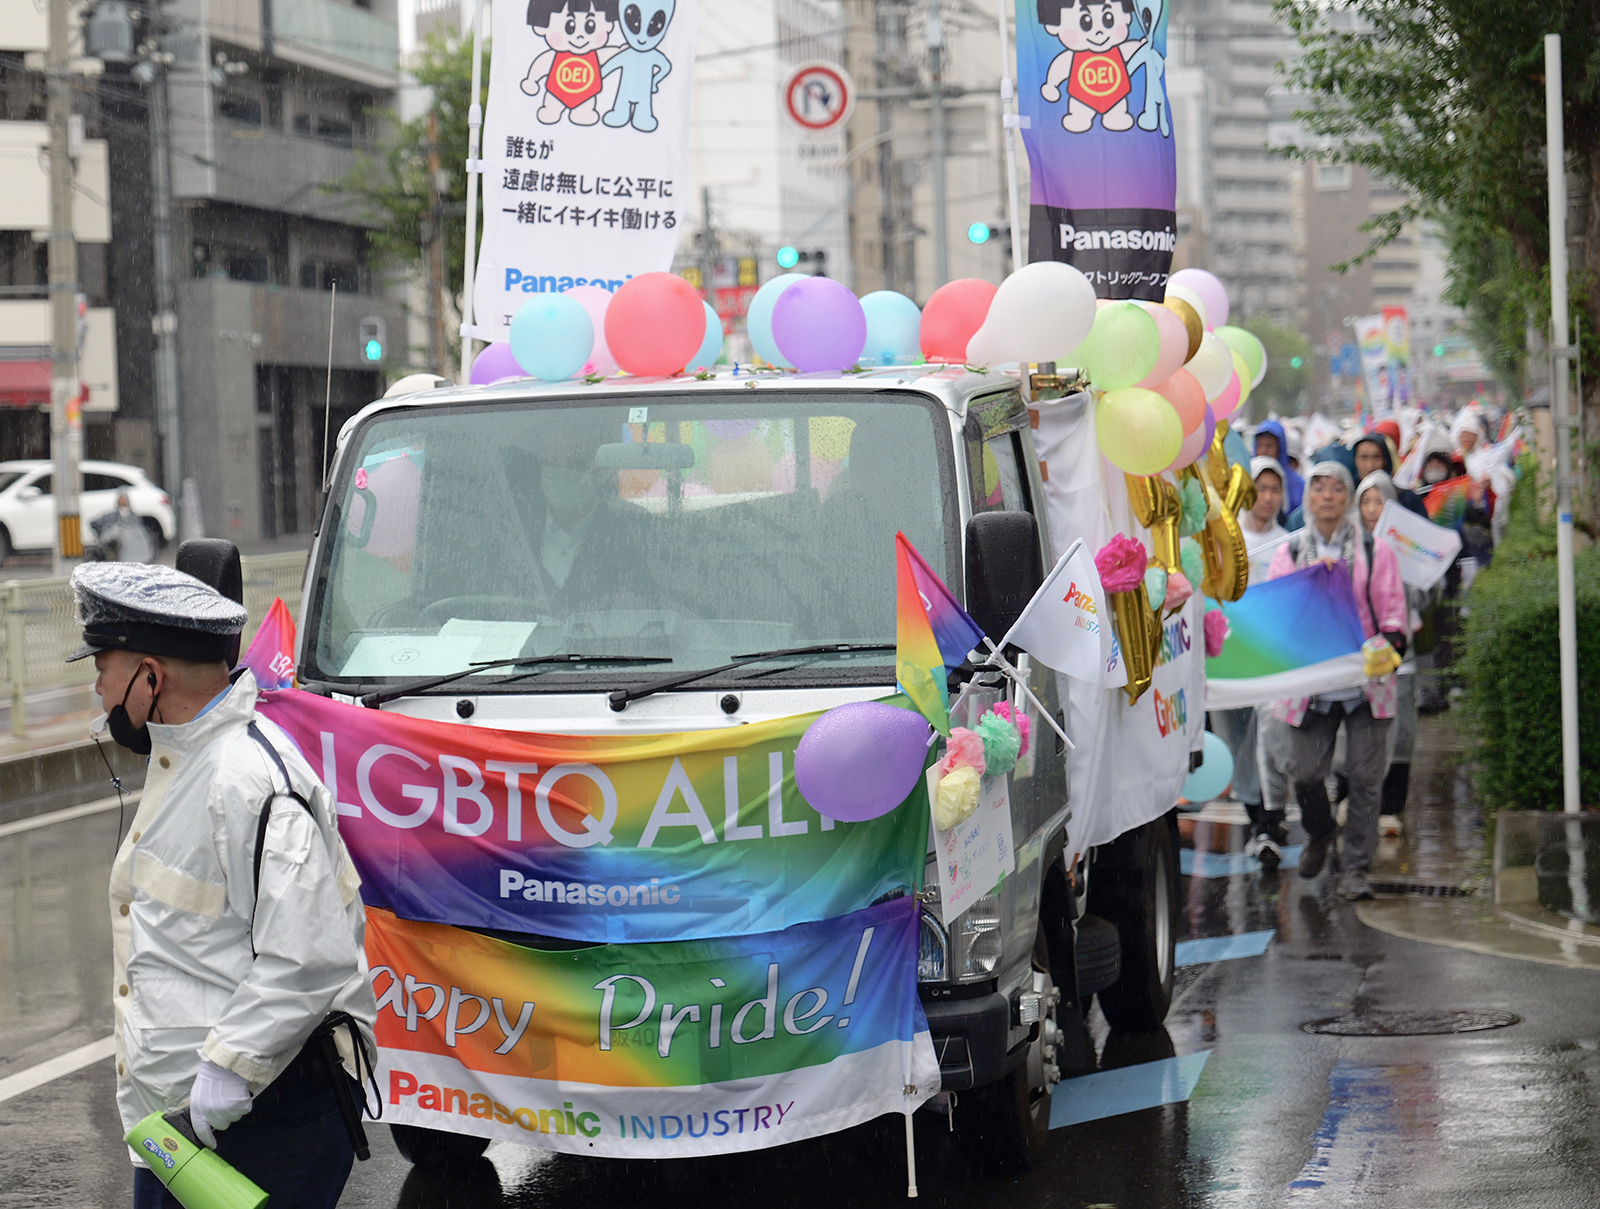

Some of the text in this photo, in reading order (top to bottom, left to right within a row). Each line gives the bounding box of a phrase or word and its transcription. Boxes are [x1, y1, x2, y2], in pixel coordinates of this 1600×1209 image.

[562, 67, 588, 83] DEI
[1084, 67, 1114, 86] DEI
[506, 136, 554, 160] 誰もが
[502, 168, 673, 199] 遠慮は無しに公平に
[502, 201, 677, 230] 一緒にイキイキ働ける
[1059, 223, 1176, 253] Panasonic
[320, 731, 618, 849] LGBTQ
[500, 869, 681, 908] Panasonic
[366, 926, 876, 1059] appy Pride!
[389, 1069, 795, 1140] Panasonic INDUSTRY
